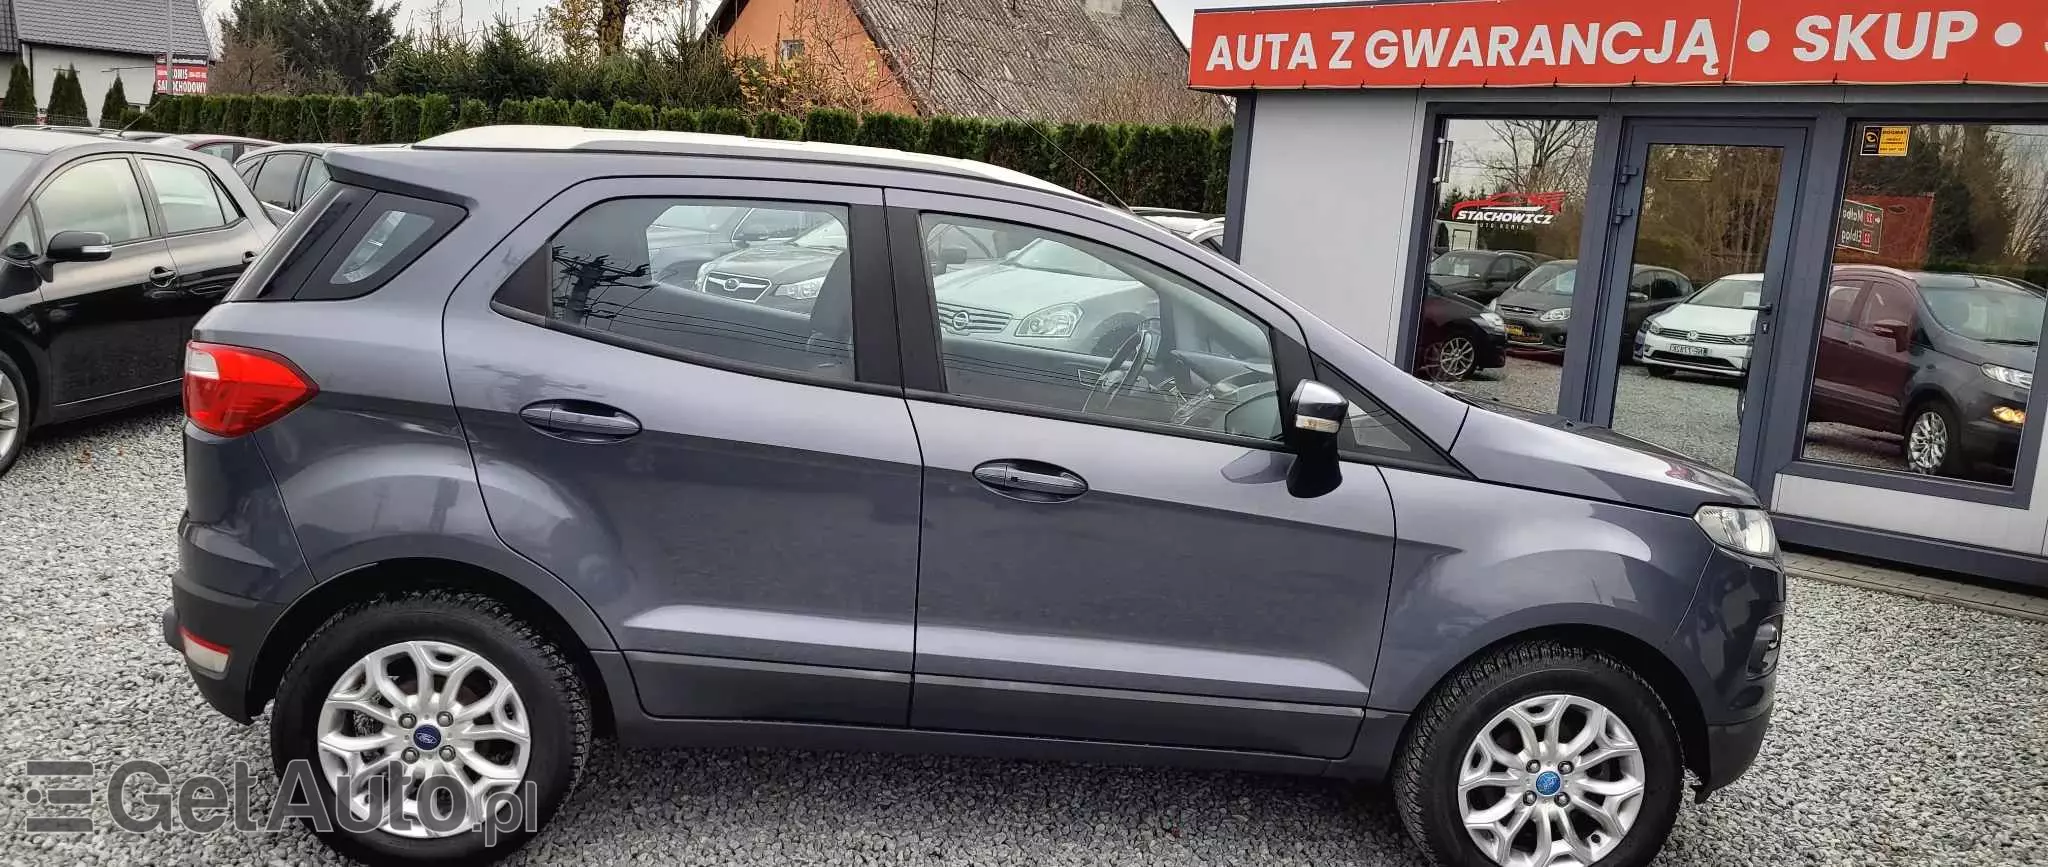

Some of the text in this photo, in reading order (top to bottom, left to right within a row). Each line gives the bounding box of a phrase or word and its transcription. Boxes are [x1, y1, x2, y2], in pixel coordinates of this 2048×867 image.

[1205, 10, 1979, 76] AUTA Z GWARANCJĄ SKUP
[1456, 210, 1555, 225] STACHOWICZ
